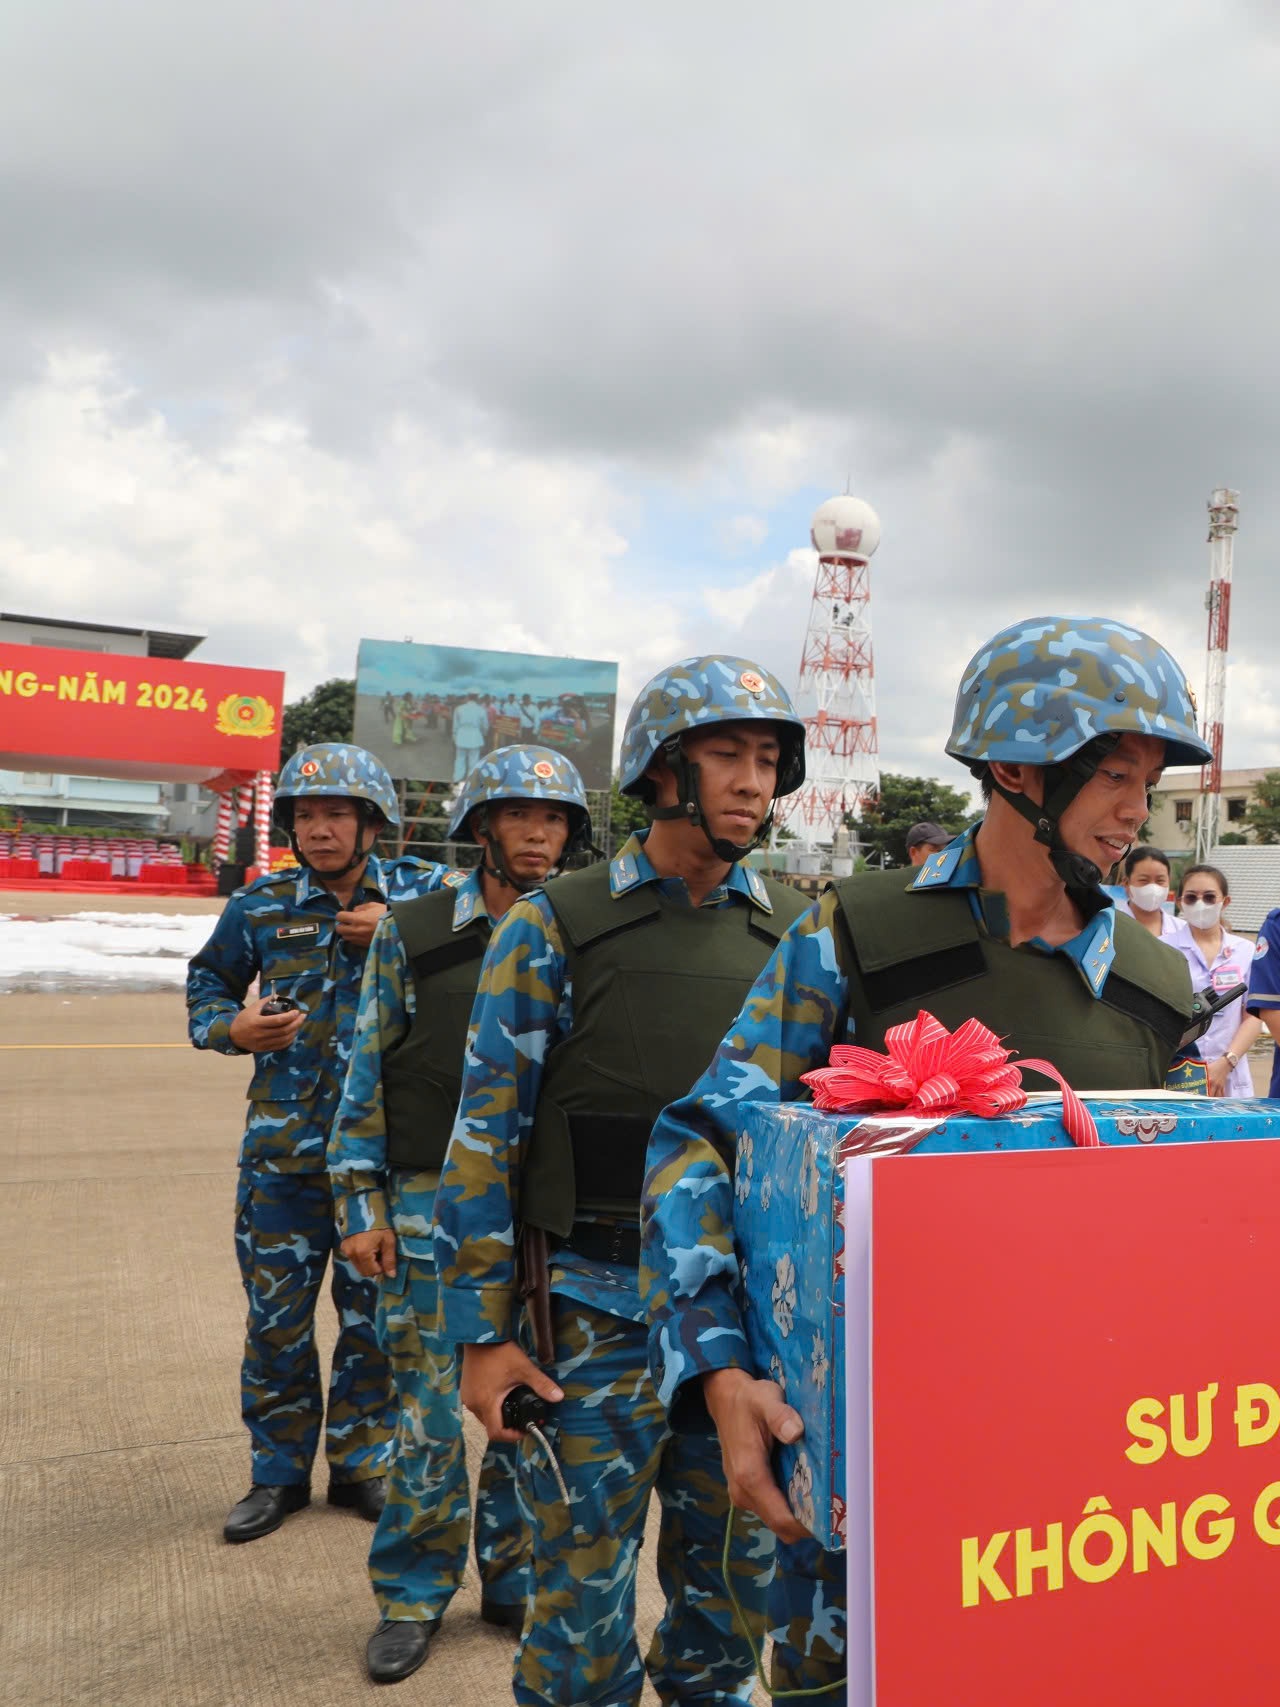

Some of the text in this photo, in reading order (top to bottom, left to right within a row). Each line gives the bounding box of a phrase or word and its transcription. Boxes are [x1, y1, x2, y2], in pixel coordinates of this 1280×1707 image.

[136, 682, 208, 713] 2024
[1124, 1382, 1219, 1465] SƯ
[961, 1495, 1235, 1608] KHÔNG
